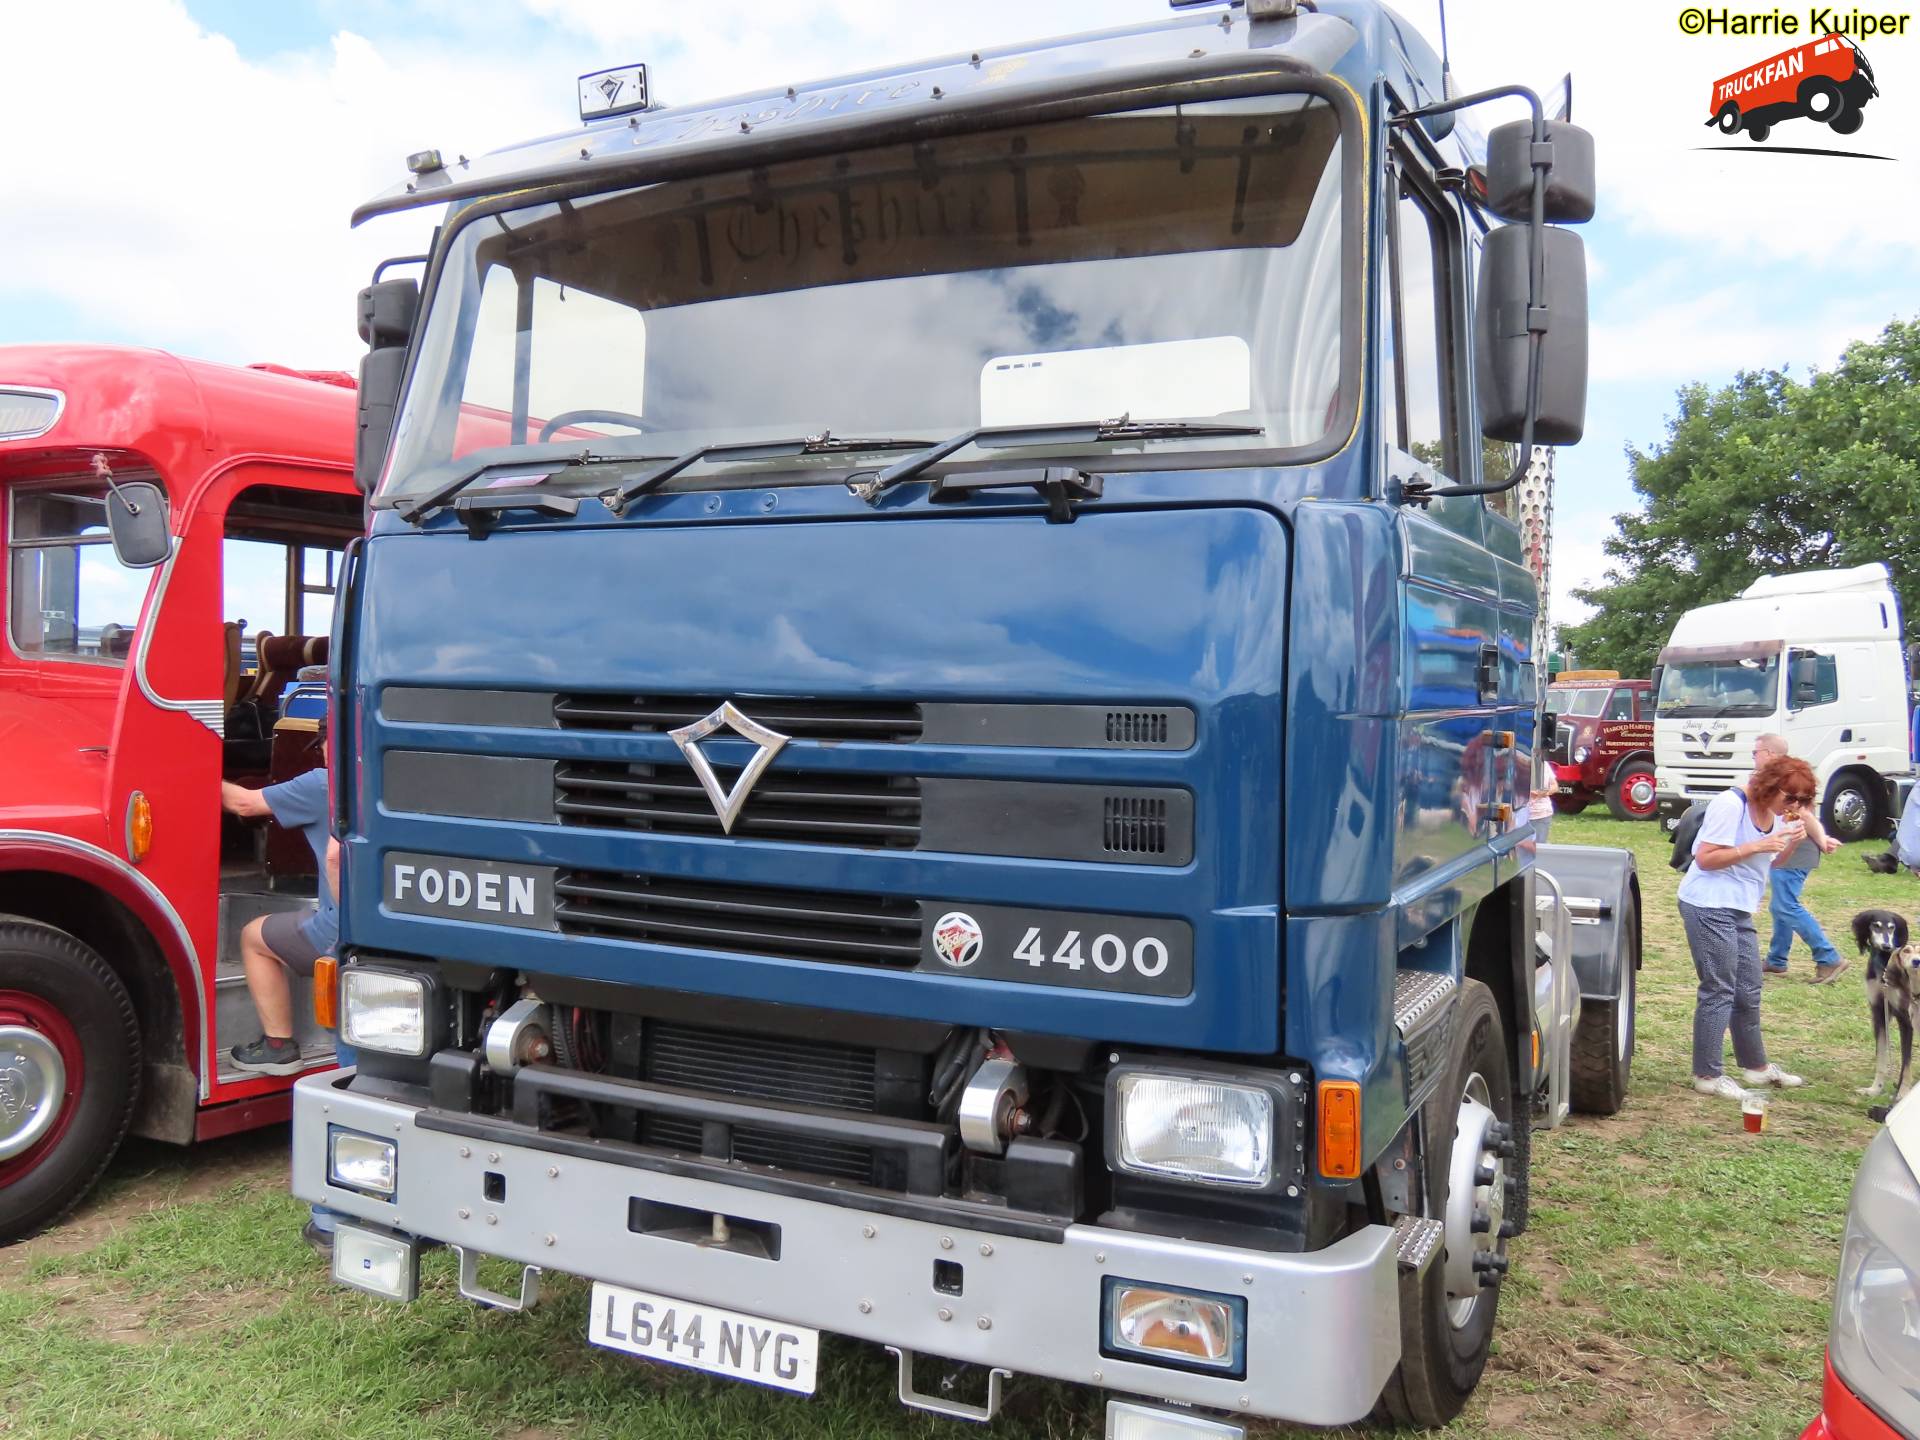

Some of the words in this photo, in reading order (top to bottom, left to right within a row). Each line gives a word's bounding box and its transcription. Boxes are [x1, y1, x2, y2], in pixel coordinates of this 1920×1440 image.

[394, 864, 536, 915] FODEN
[1013, 927, 1168, 977] 4400
[605, 1295, 705, 1358] L644
[718, 1320, 799, 1380] NYG
